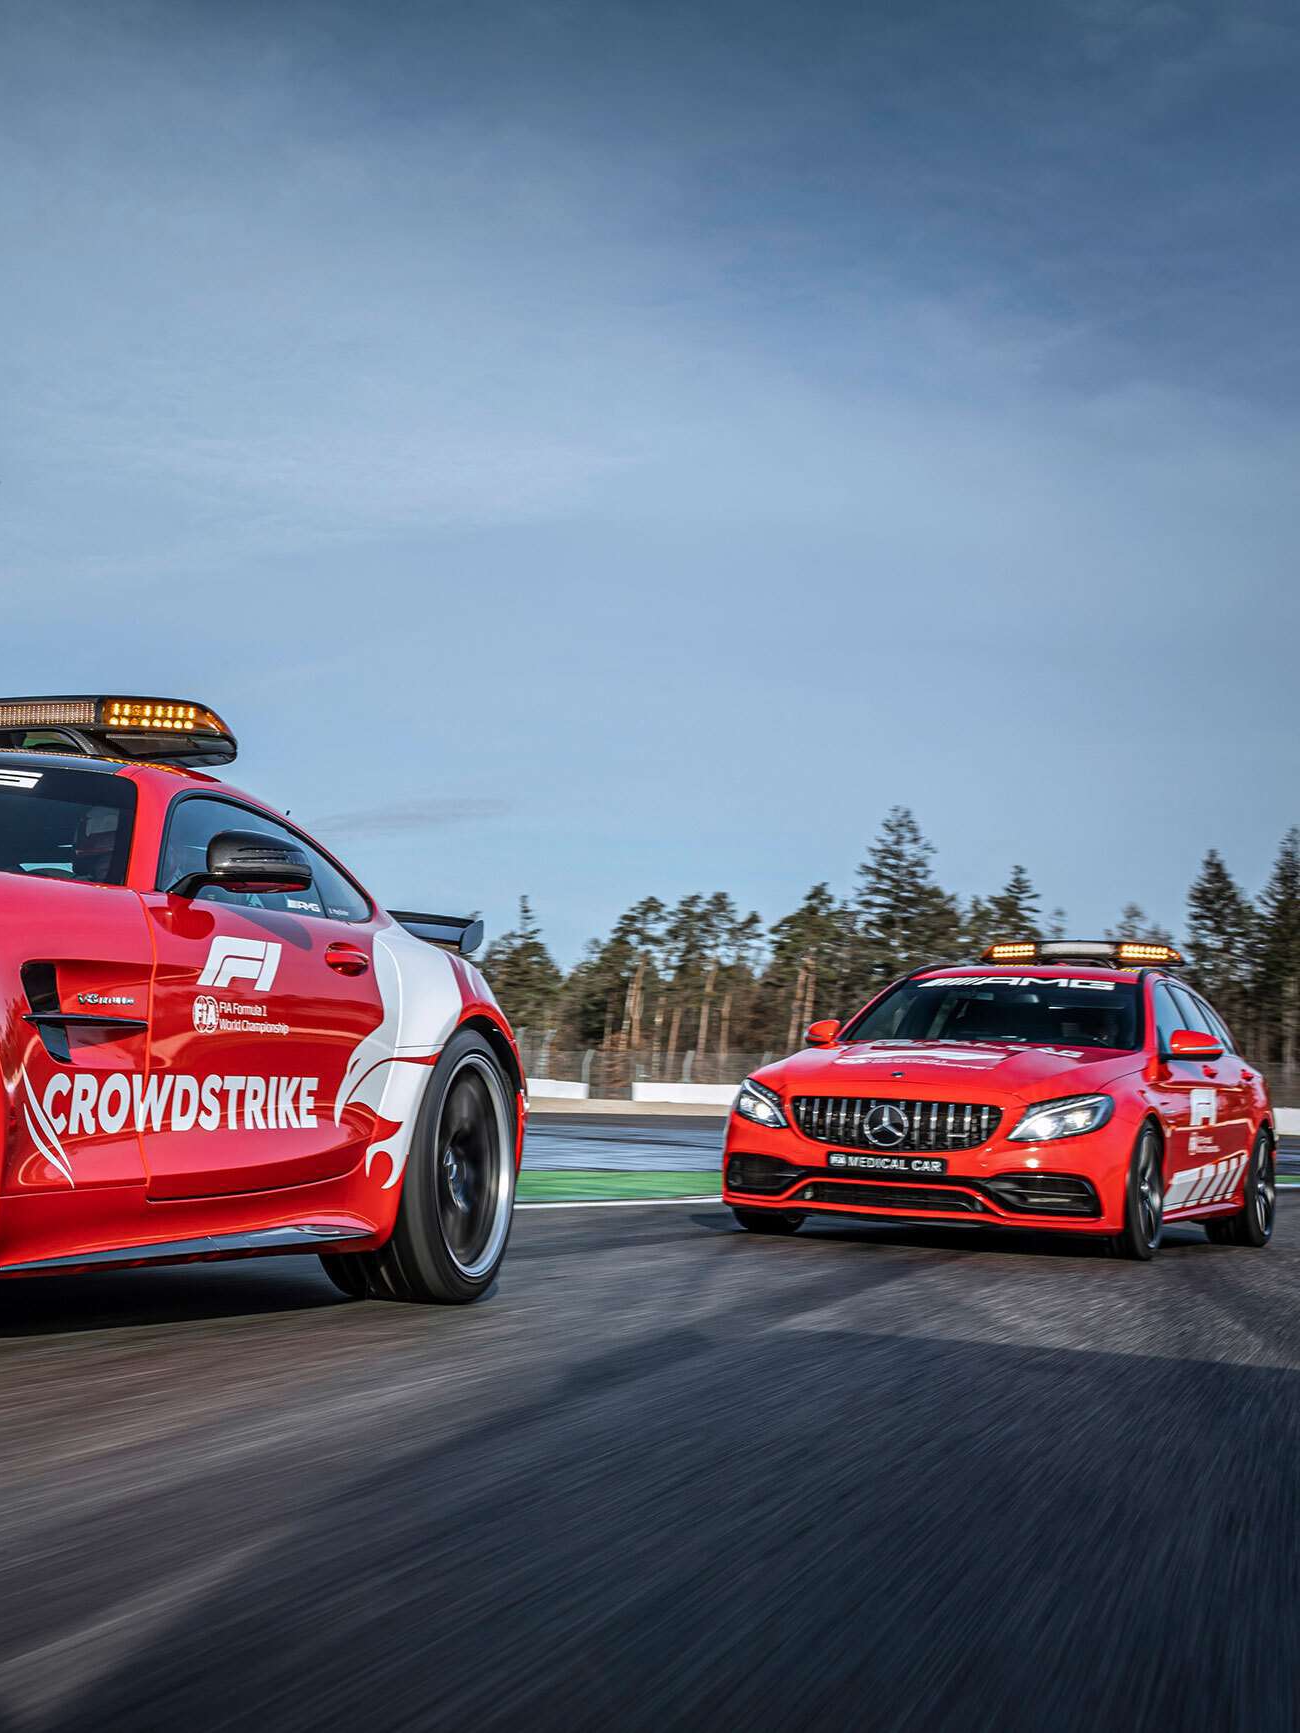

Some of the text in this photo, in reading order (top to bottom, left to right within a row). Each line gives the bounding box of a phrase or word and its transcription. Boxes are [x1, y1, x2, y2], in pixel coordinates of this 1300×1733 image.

[196, 935, 282, 992] F1
[972, 977, 1116, 991] AMG
[219, 1002, 233, 1014] FIA
[233, 1003, 262, 1016] Formula
[219, 1019, 290, 1035] World Championship
[42, 1073, 319, 1136] CROWDSTRIKE
[848, 1156, 909, 1170] MEDICAL
[911, 1160, 942, 1172] CAR
